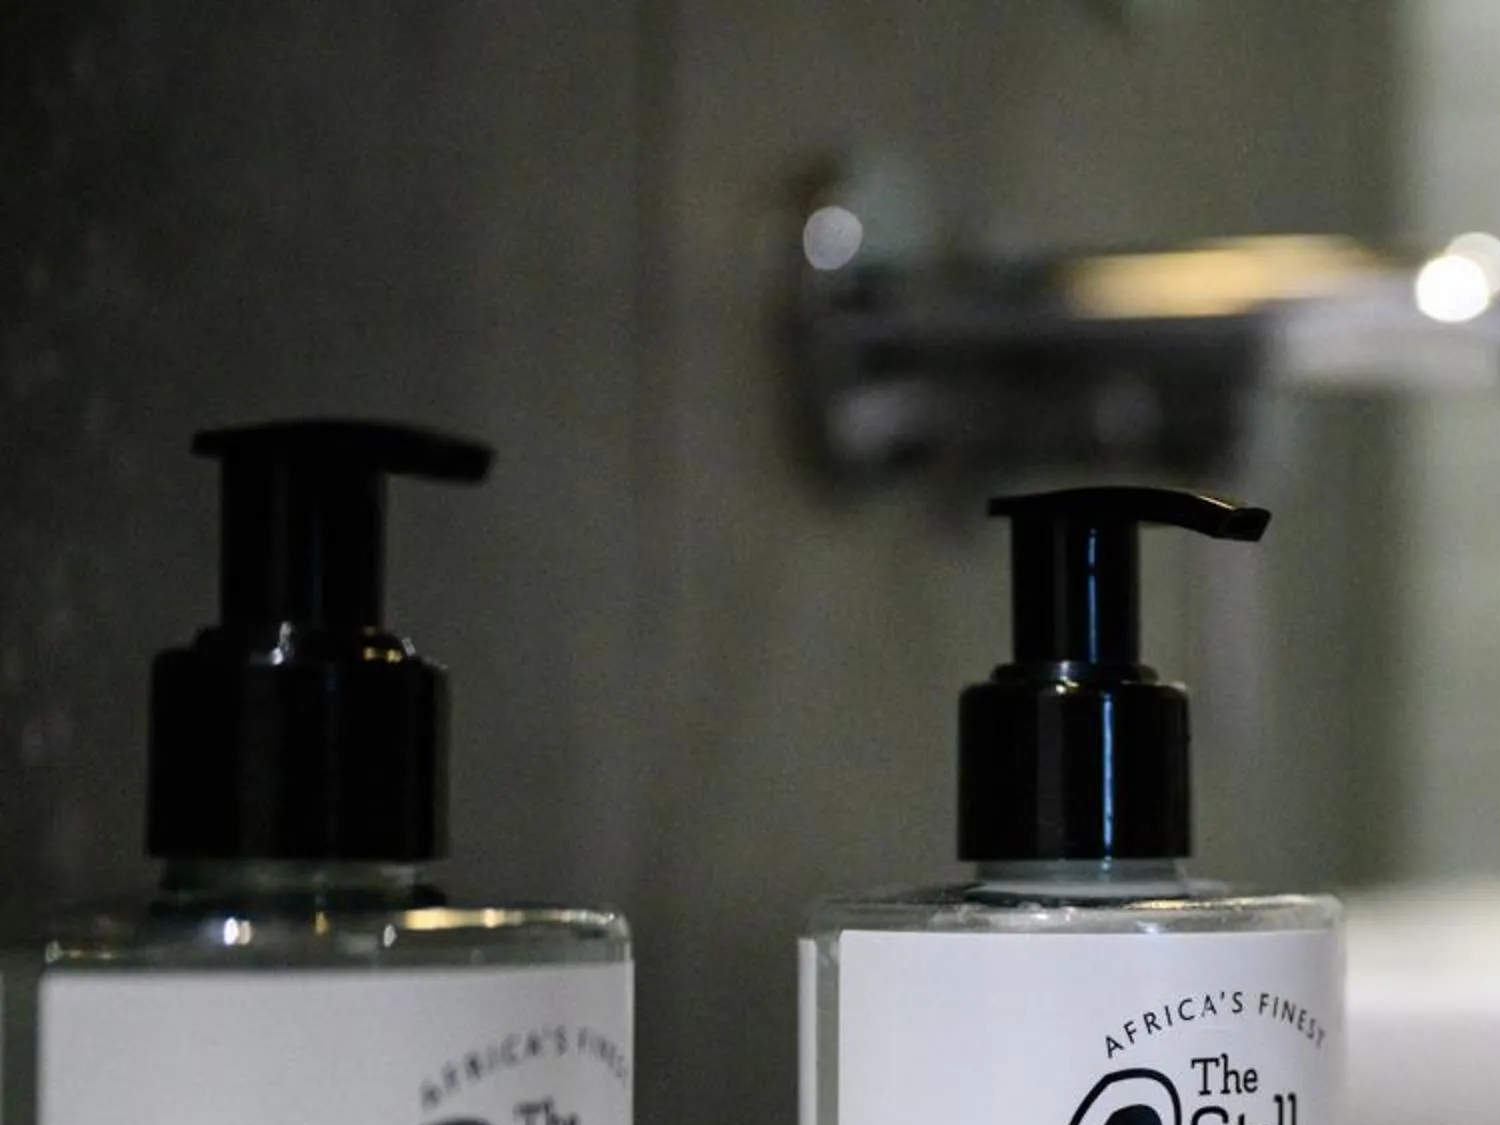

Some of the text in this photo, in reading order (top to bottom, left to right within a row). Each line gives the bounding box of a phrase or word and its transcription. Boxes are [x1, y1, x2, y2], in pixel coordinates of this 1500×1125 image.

[1104, 991, 1327, 1059] AFRICA'S FINEST
[1190, 1053, 1259, 1096] The
